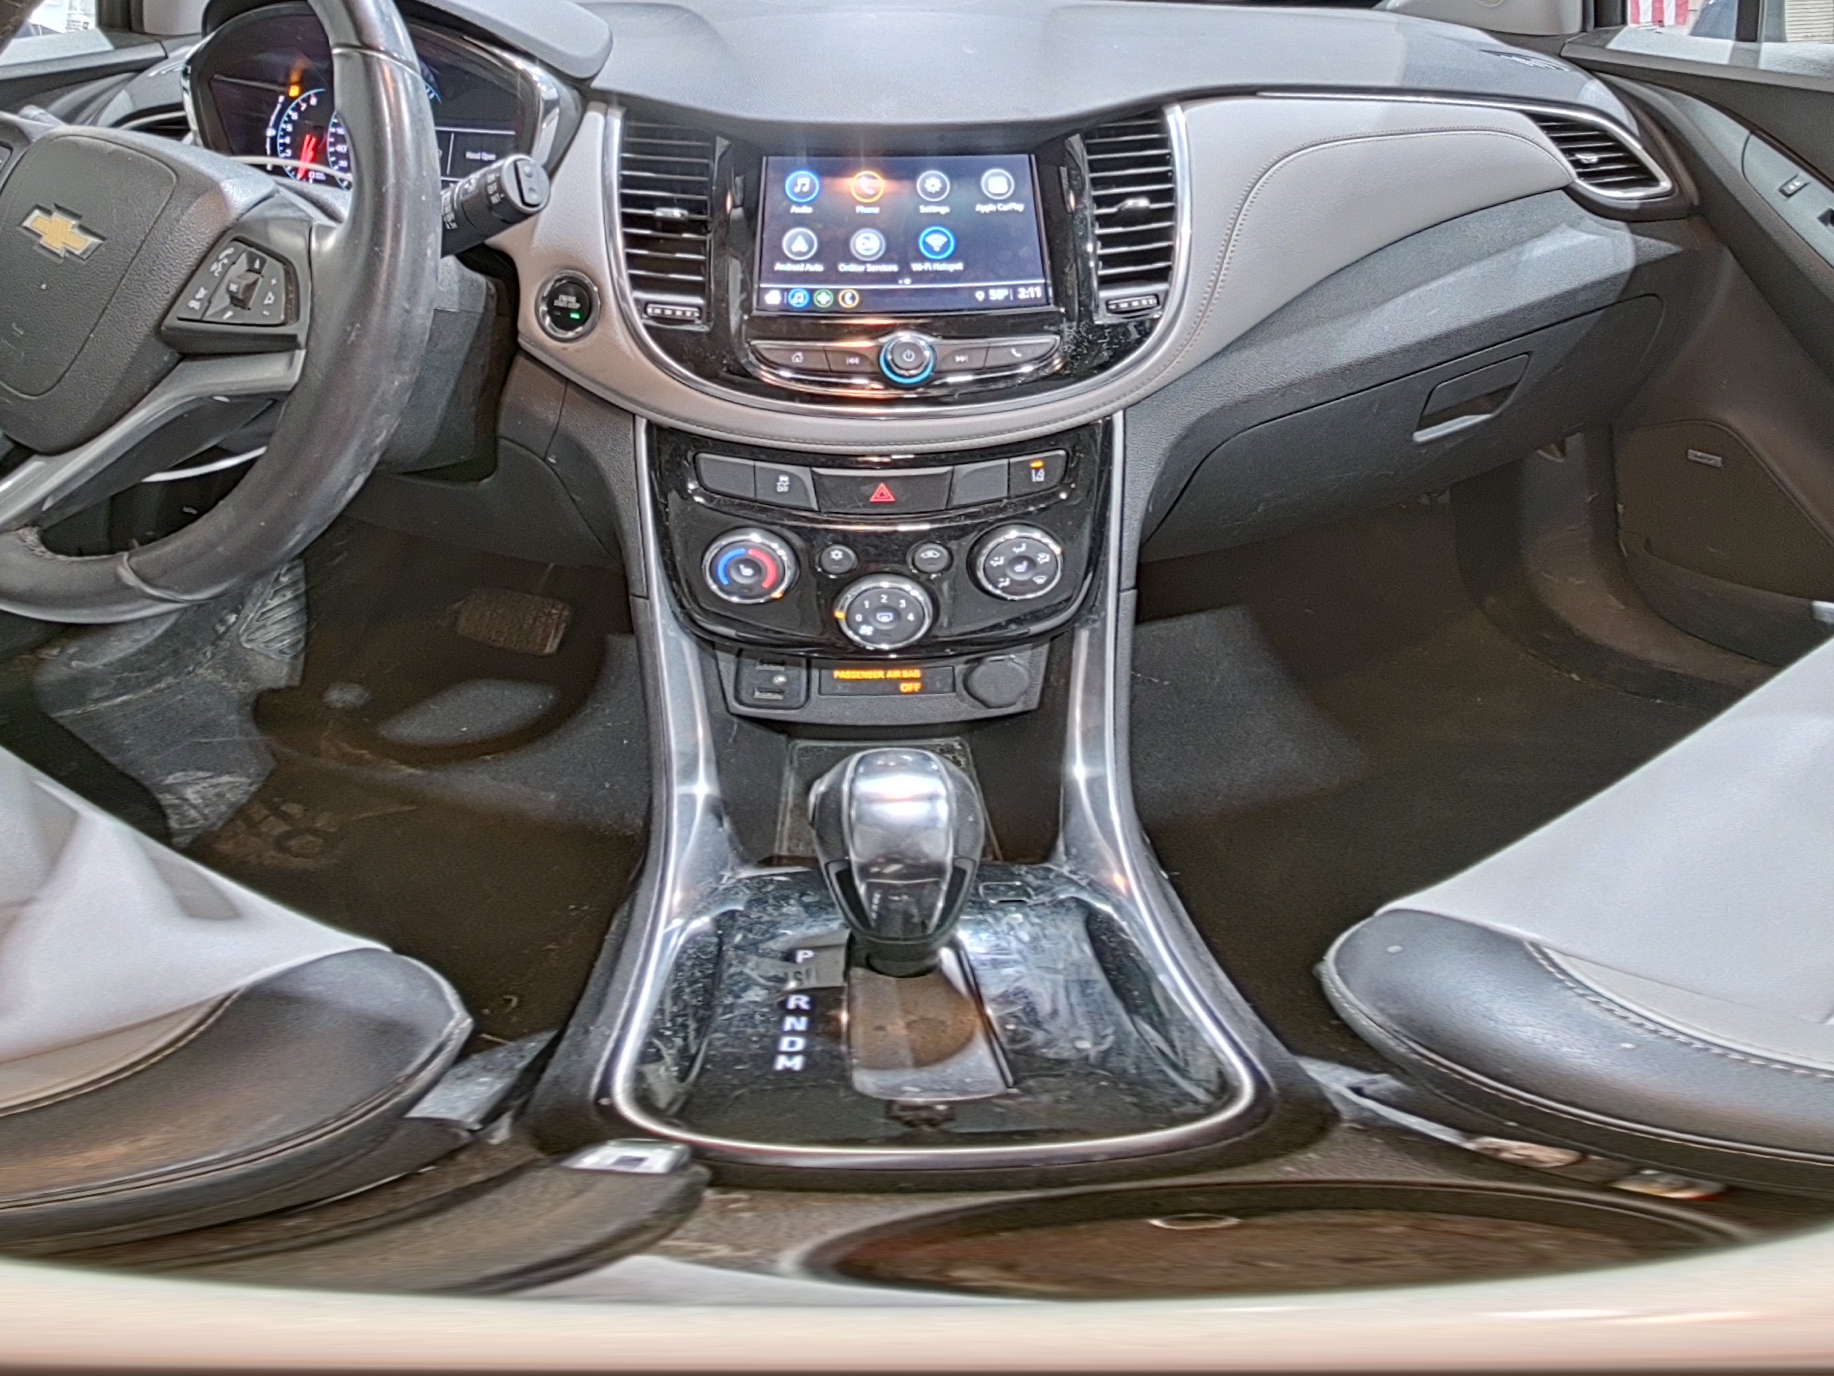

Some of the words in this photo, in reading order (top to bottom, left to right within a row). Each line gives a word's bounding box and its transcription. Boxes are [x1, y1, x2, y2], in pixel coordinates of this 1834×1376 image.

[466, 151, 480, 159] Hood
[481, 152, 496, 161] Open
[855, 205, 879, 213] Phone
[919, 205, 950, 214] Settings
[975, 204, 996, 213] Apple
[997, 203, 1024, 212] CarPlay
[774, 262, 804, 271] Android
[805, 263, 824, 272] Auto
[838, 263, 865, 272] OnStar
[866, 263, 898, 272] Services
[911, 262, 932, 271] Wi-Fi
[933, 262, 964, 272] Hotspot
[1018, 287, 1042, 299] 2:11
[833, 670, 884, 679] PASSENGER
[886, 670, 900, 679] AIR
[902, 670, 921, 678] BAG
[900, 682, 922, 692] OFF
[796, 950, 814, 963] P
[786, 995, 811, 1010] R
[783, 1016, 808, 1031] N
[779, 1036, 805, 1052] D
[774, 1055, 804, 1071] M
